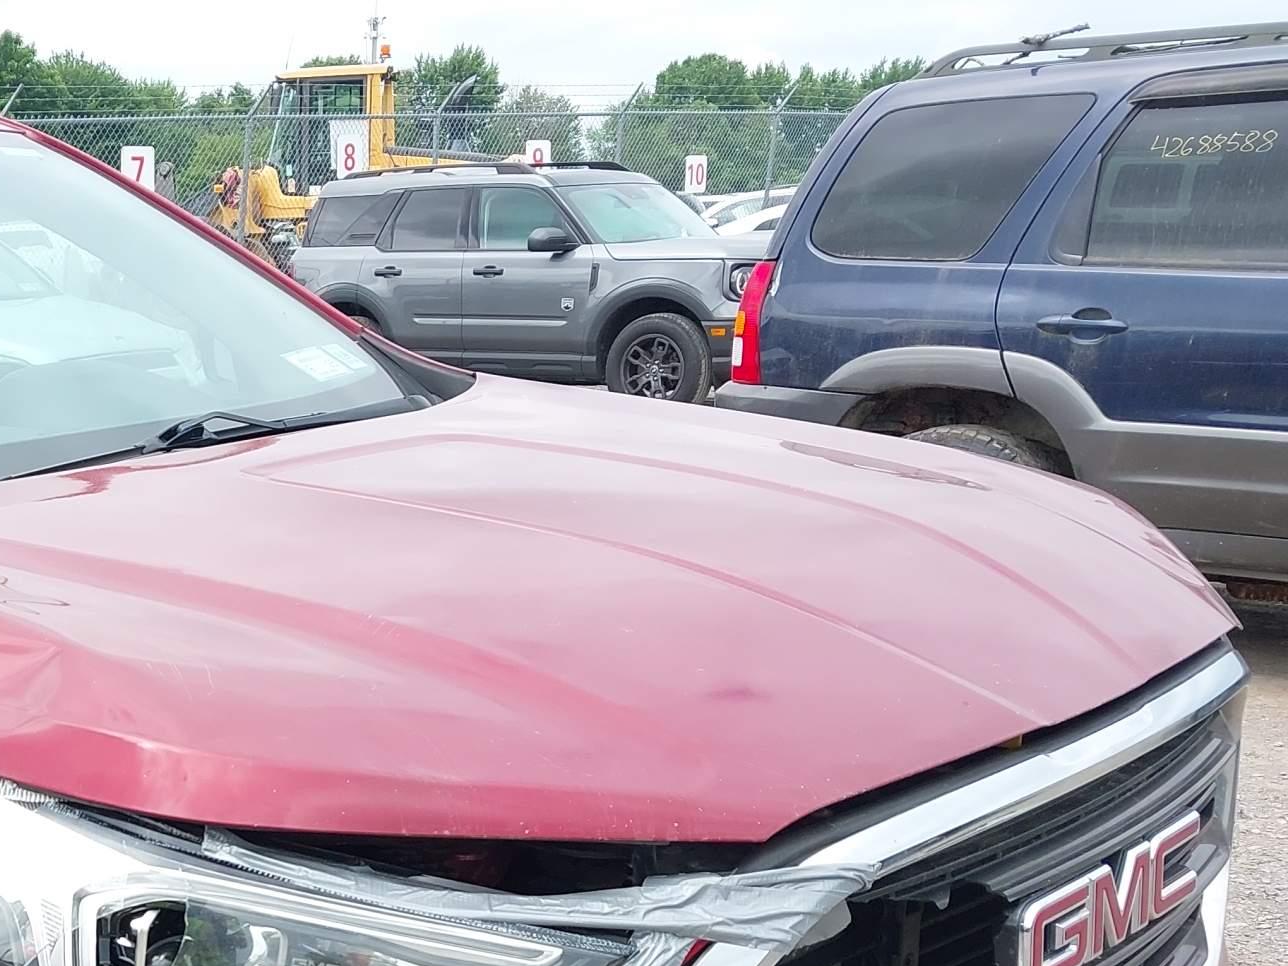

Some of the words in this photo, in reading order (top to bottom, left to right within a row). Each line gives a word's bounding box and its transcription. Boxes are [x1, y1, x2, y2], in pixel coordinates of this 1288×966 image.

[344, 143, 355, 171] 8
[1150, 130, 1279, 158] 42688588
[130, 156, 145, 182] 7
[688, 163, 705, 186] 10
